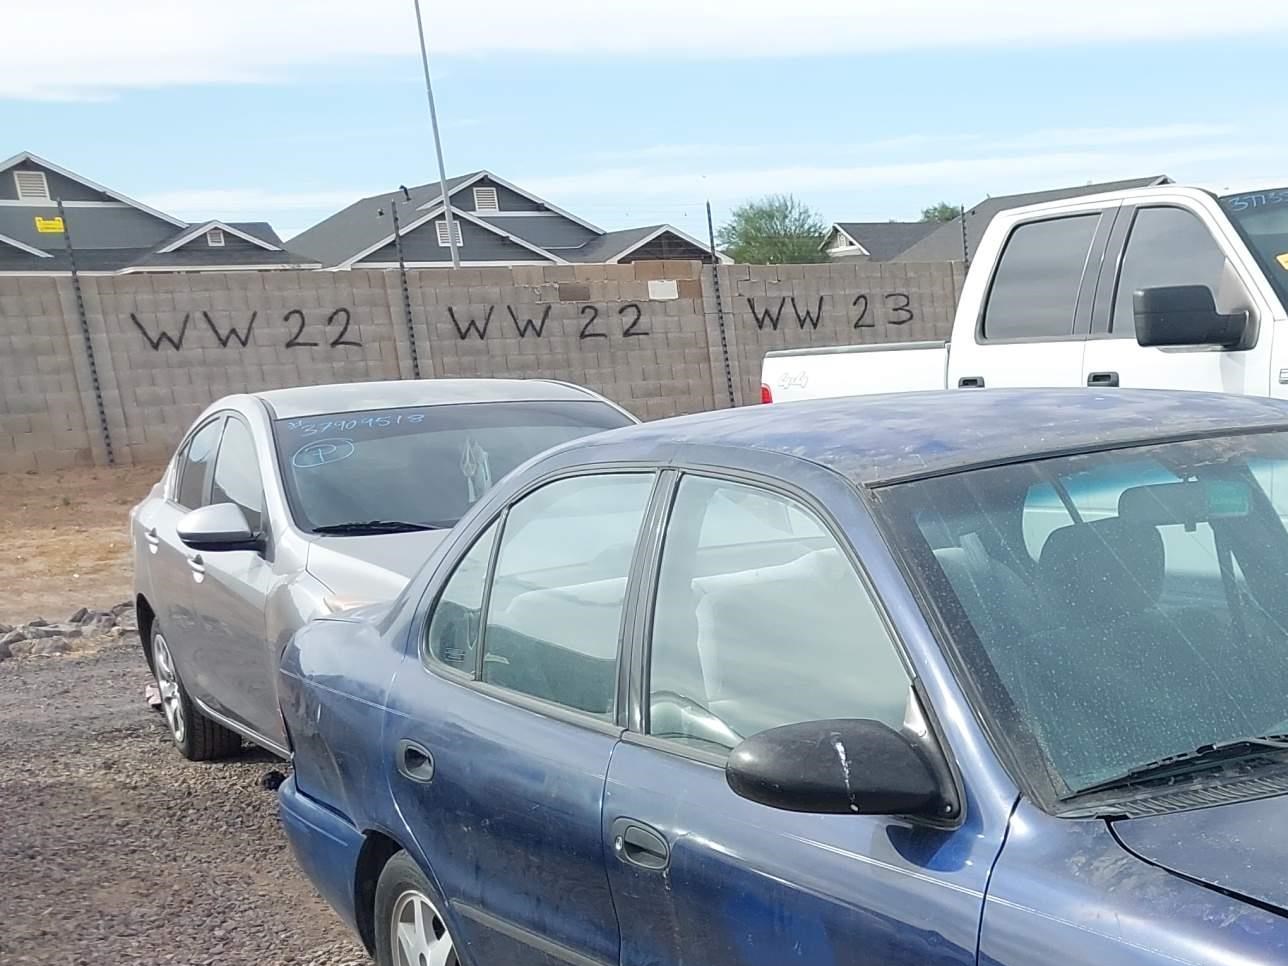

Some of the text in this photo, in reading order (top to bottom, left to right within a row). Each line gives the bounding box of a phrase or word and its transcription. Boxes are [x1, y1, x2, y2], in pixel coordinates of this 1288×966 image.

[283, 307, 363, 349] 22
[579, 303, 650, 339] 22
[746, 293, 914, 331] WW 23
